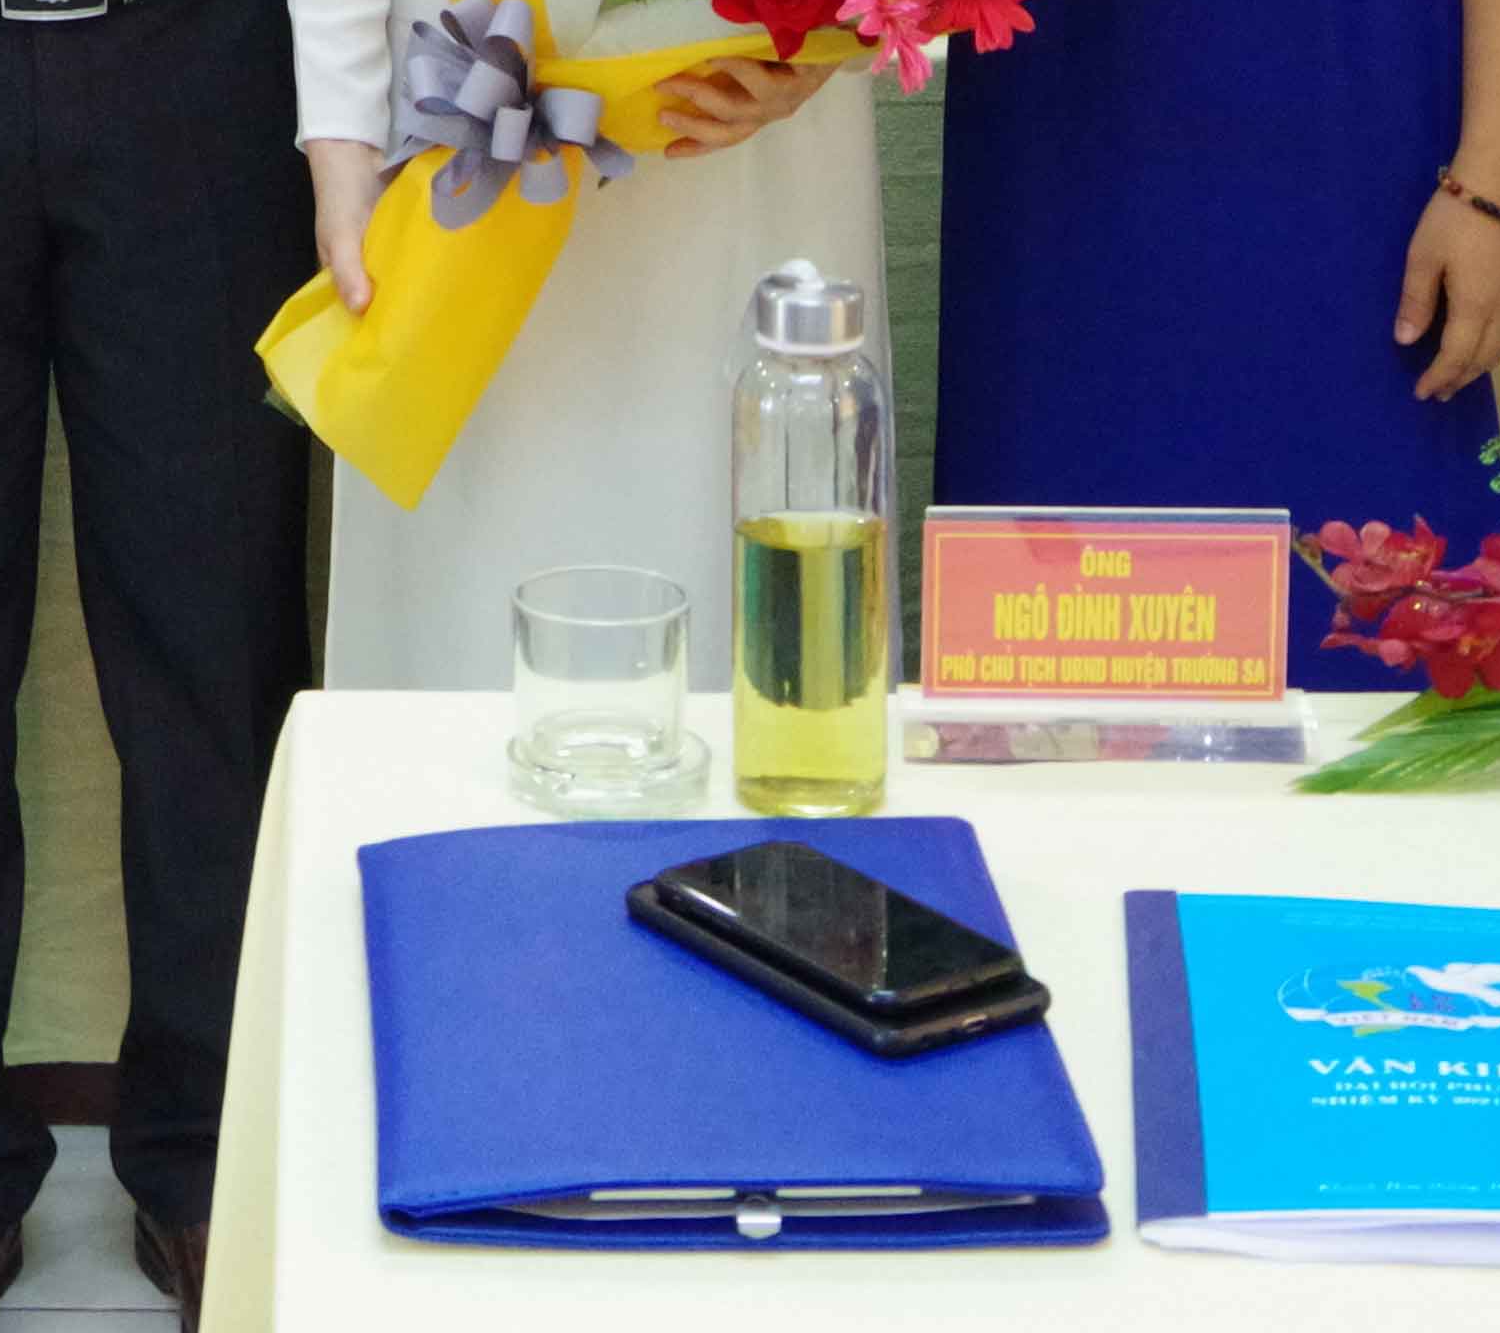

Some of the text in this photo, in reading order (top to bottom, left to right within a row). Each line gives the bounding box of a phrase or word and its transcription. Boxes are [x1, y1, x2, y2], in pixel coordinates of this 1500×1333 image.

[1080, 545, 1132, 578] ÔNG
[994, 582, 1216, 642] NGÔ ĐÌNH XUYÊN
[1242, 657, 1265, 683] SA
